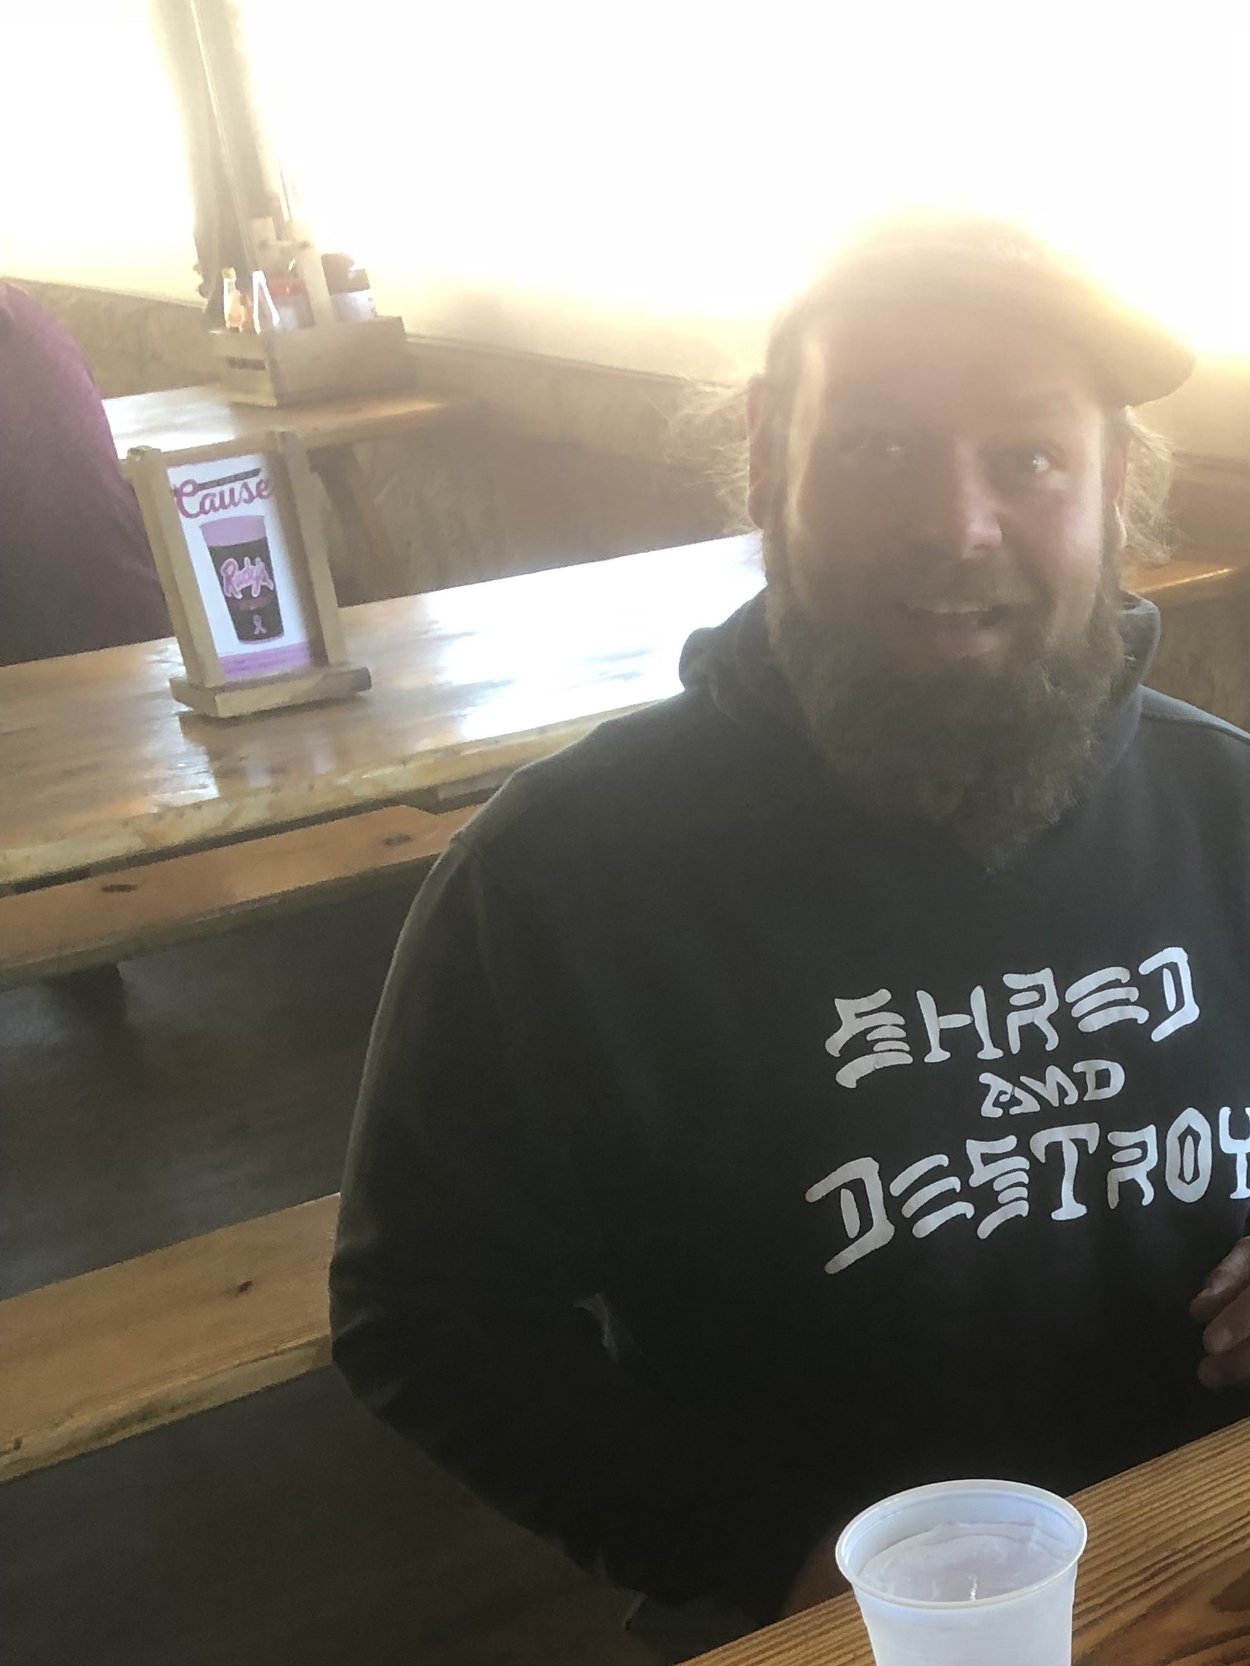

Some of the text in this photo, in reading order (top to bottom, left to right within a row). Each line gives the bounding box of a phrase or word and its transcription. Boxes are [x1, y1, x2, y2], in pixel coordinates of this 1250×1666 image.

[174, 478, 274, 519] Cause
[824, 946, 1200, 1089] SHRED
[978, 1059, 1125, 1118] AND
